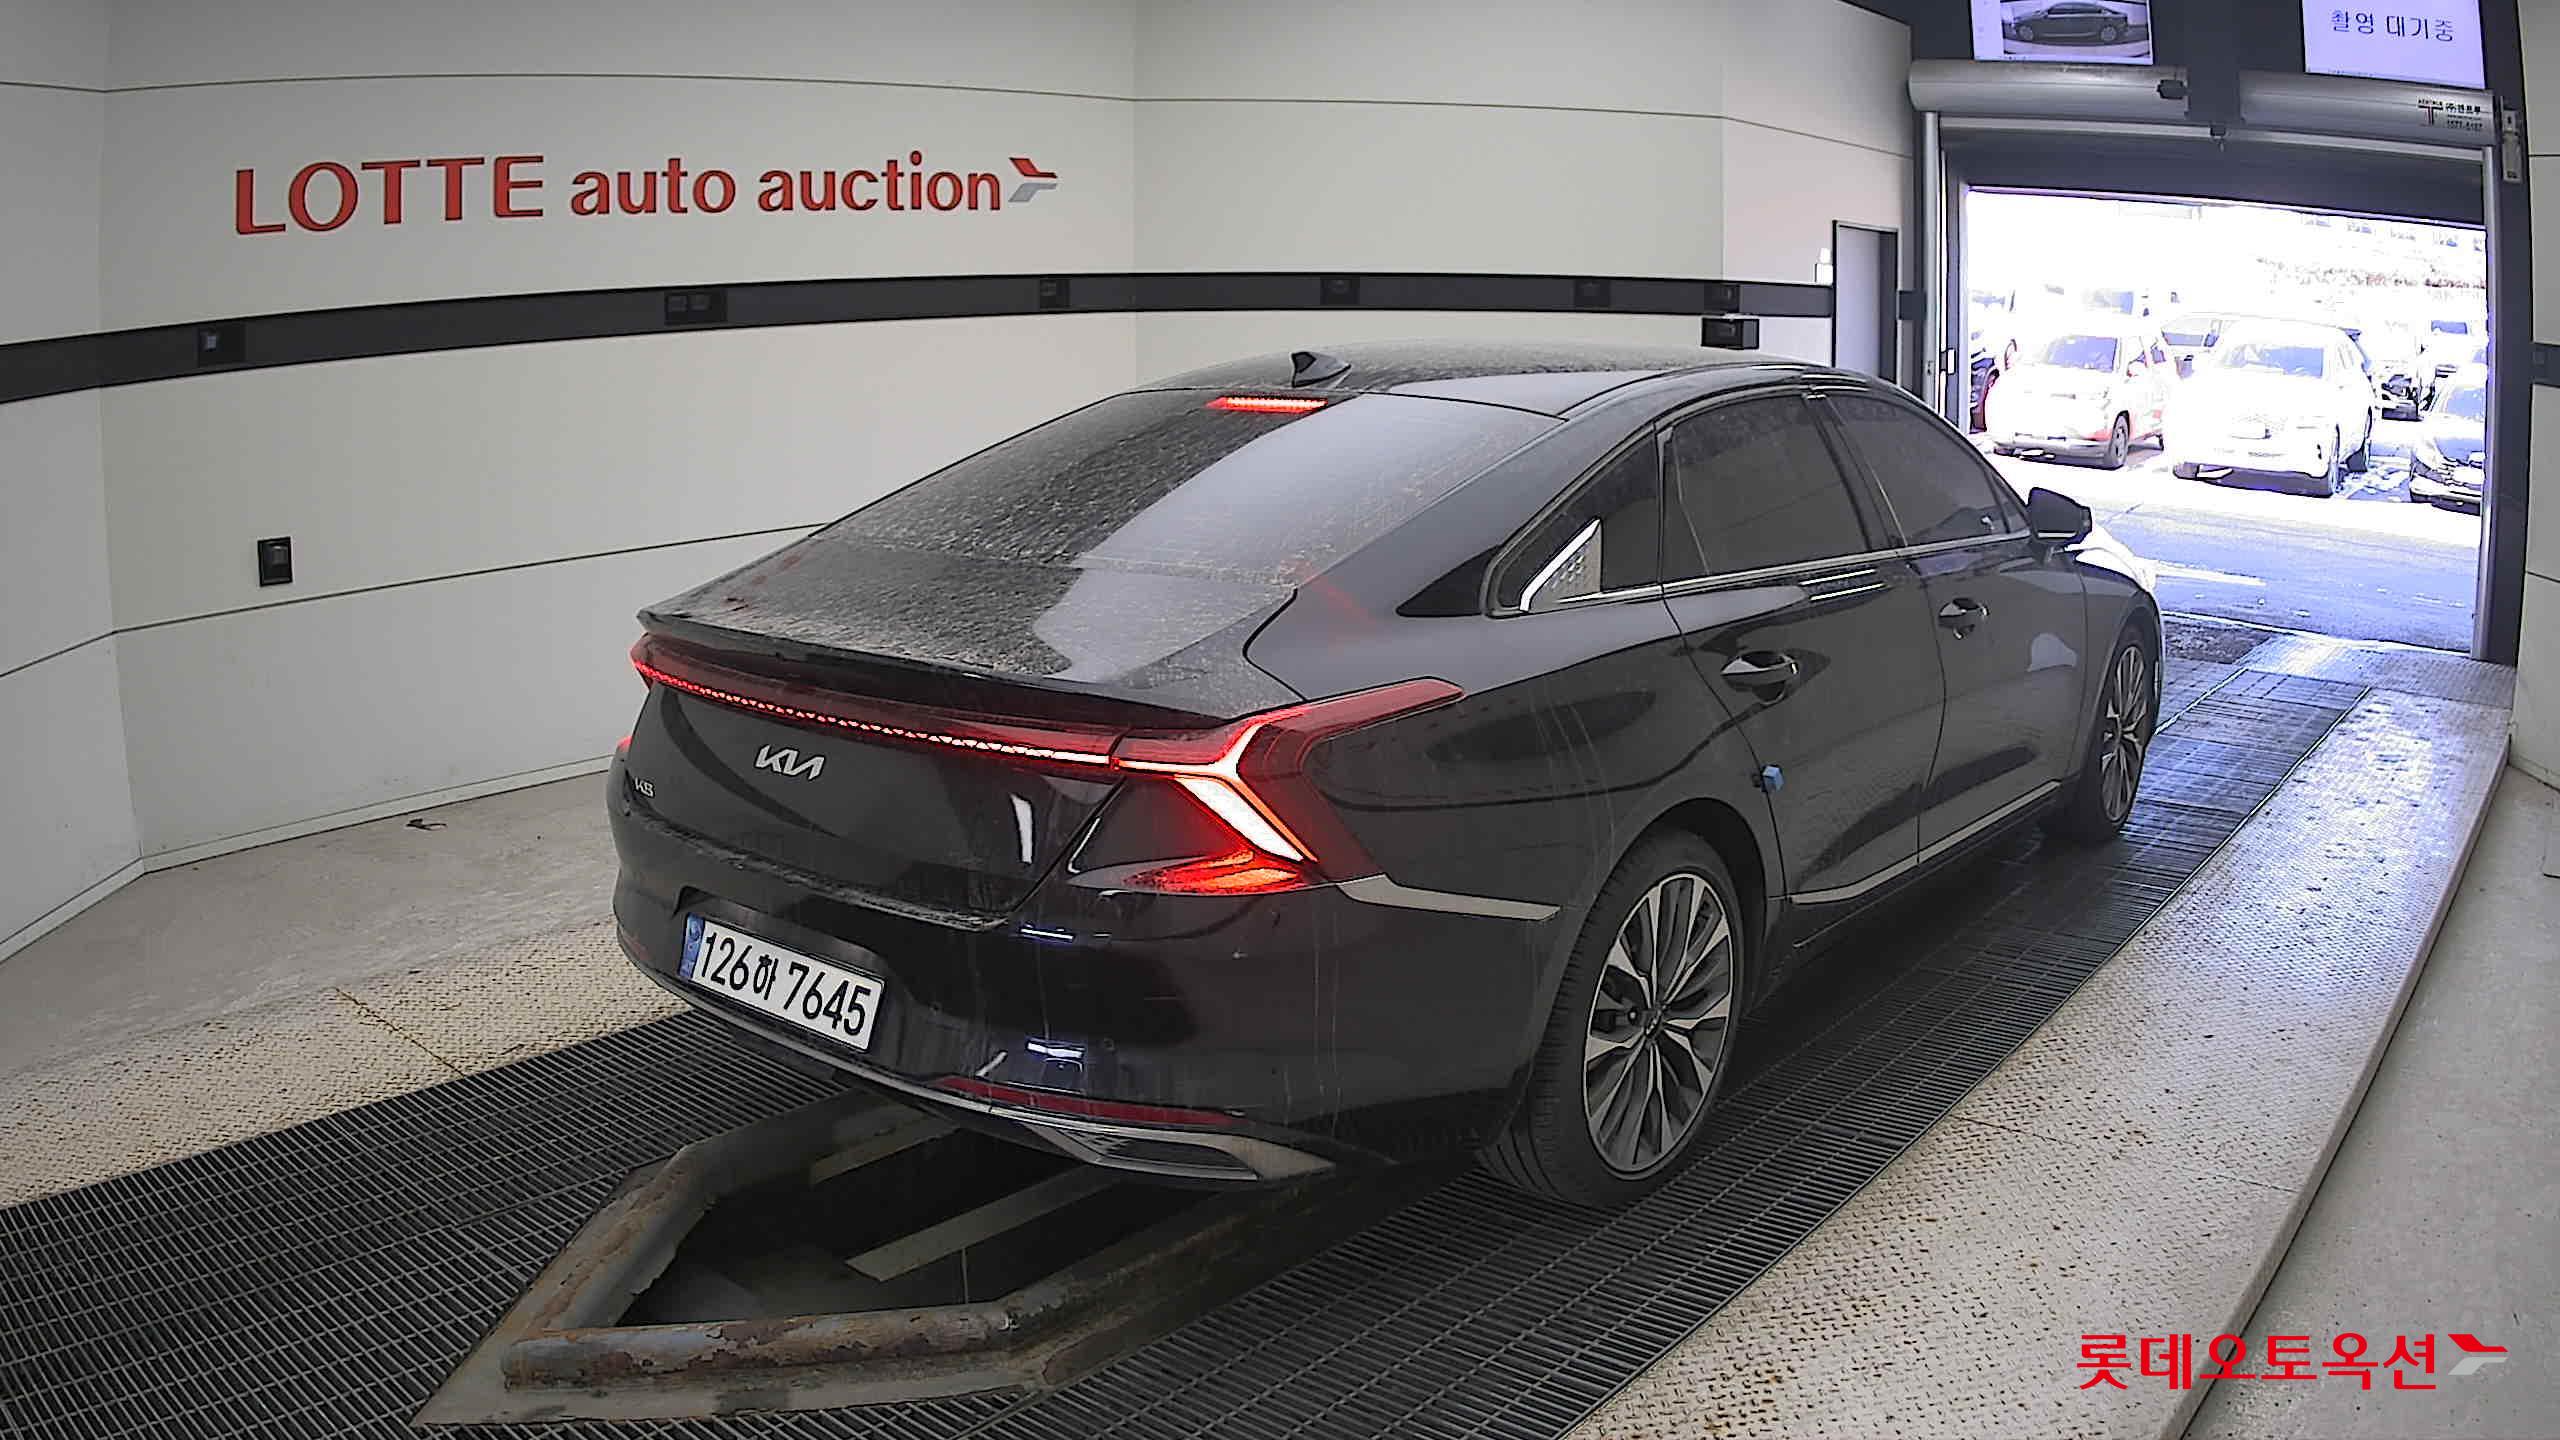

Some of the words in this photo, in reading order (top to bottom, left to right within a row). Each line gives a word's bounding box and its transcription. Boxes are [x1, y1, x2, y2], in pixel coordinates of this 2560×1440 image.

[2331, 9, 2375, 35] 촬영
[2385, 15, 2454, 42] 대기중
[235, 154, 545, 236] LOTTE
[570, 156, 737, 216] auto
[757, 150, 1001, 213] auction
[701, 931, 779, 1001] 126하
[783, 961, 872, 1036] 7645
